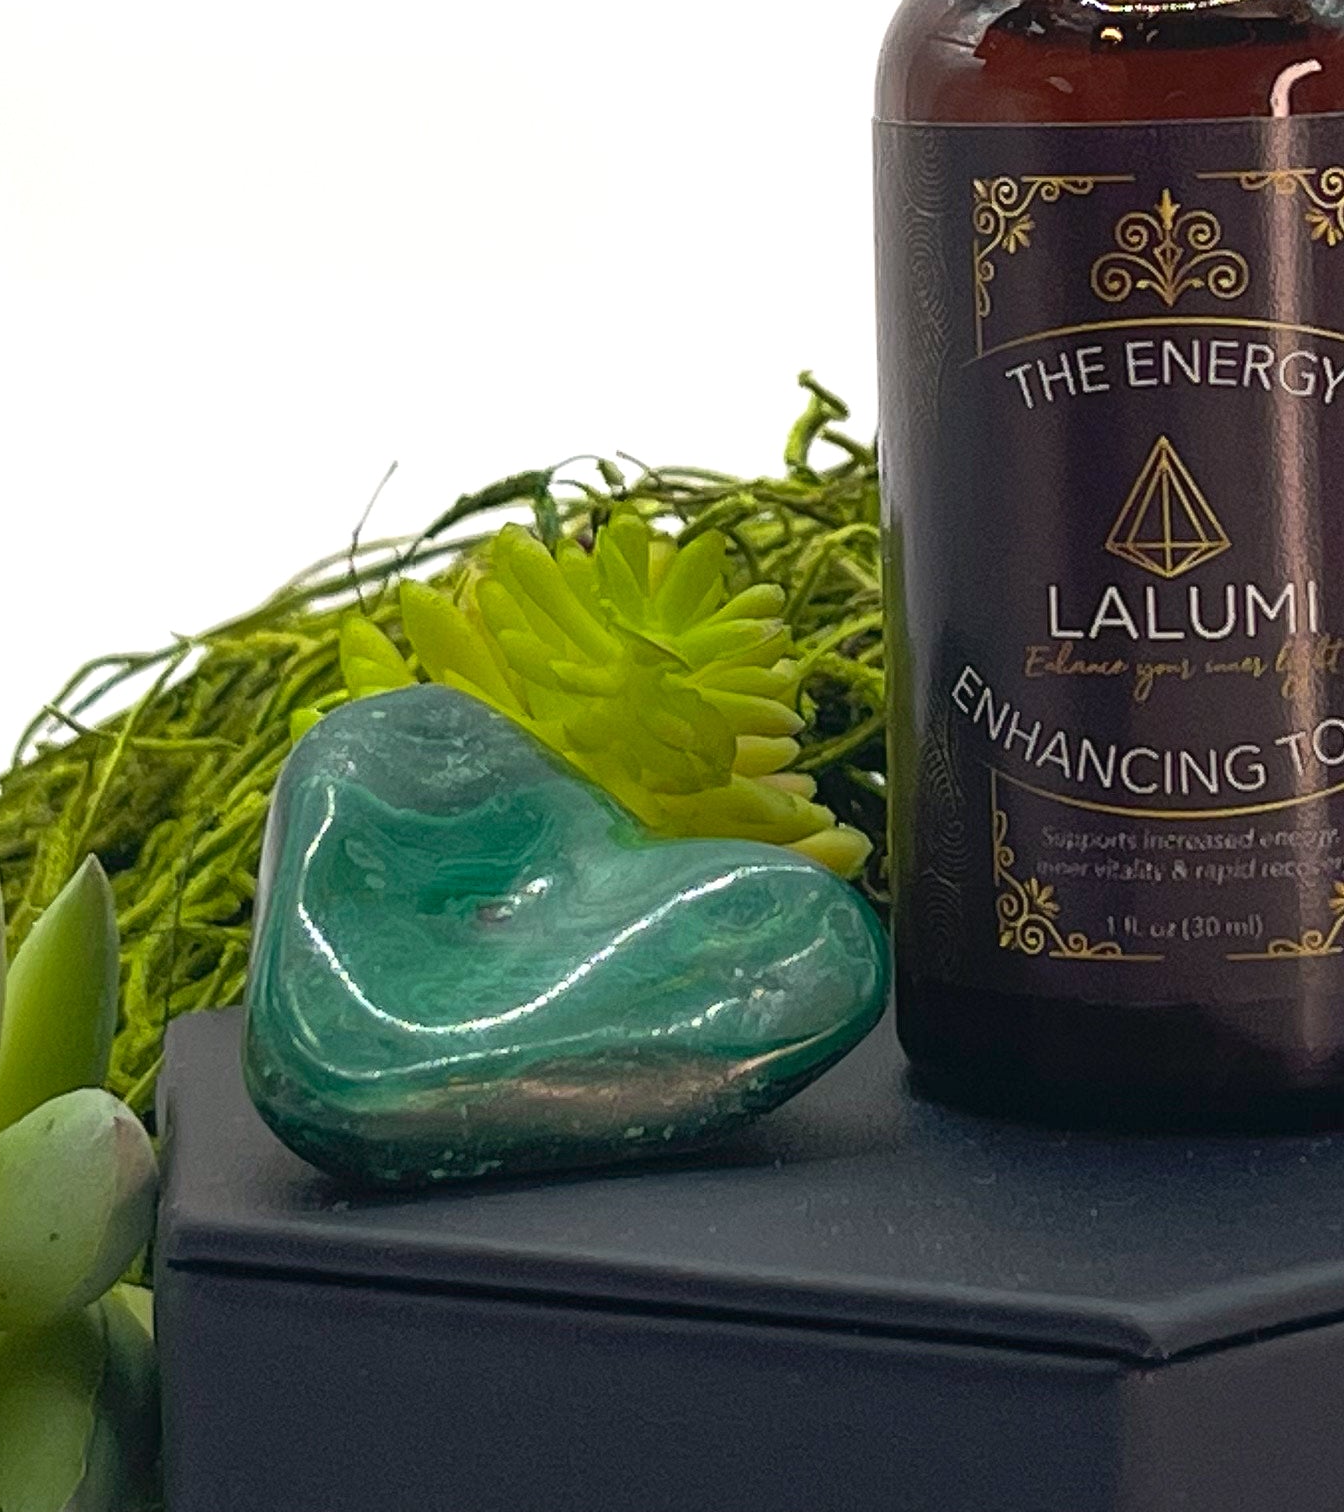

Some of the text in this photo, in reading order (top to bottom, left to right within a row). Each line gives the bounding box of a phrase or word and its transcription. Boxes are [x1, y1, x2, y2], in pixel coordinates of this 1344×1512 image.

[1005, 346, 1110, 410] THE
[1047, 582, 1320, 641] LALUMI
[1132, 657, 1197, 704] your
[1205, 656, 1268, 678] inner
[950, 665, 1267, 796] ENHANCING
[1041, 825, 1136, 853] Supports
[1143, 827, 1255, 850] increased
[1094, 858, 1163, 884] vitality
[1171, 859, 1187, 880] &
[1196, 858, 1255, 885] rapid
[1107, 914, 1116, 937] 1
[1150, 921, 1177, 938] oz
[1182, 914, 1222, 940] (30
[1226, 912, 1263, 938] ml)
